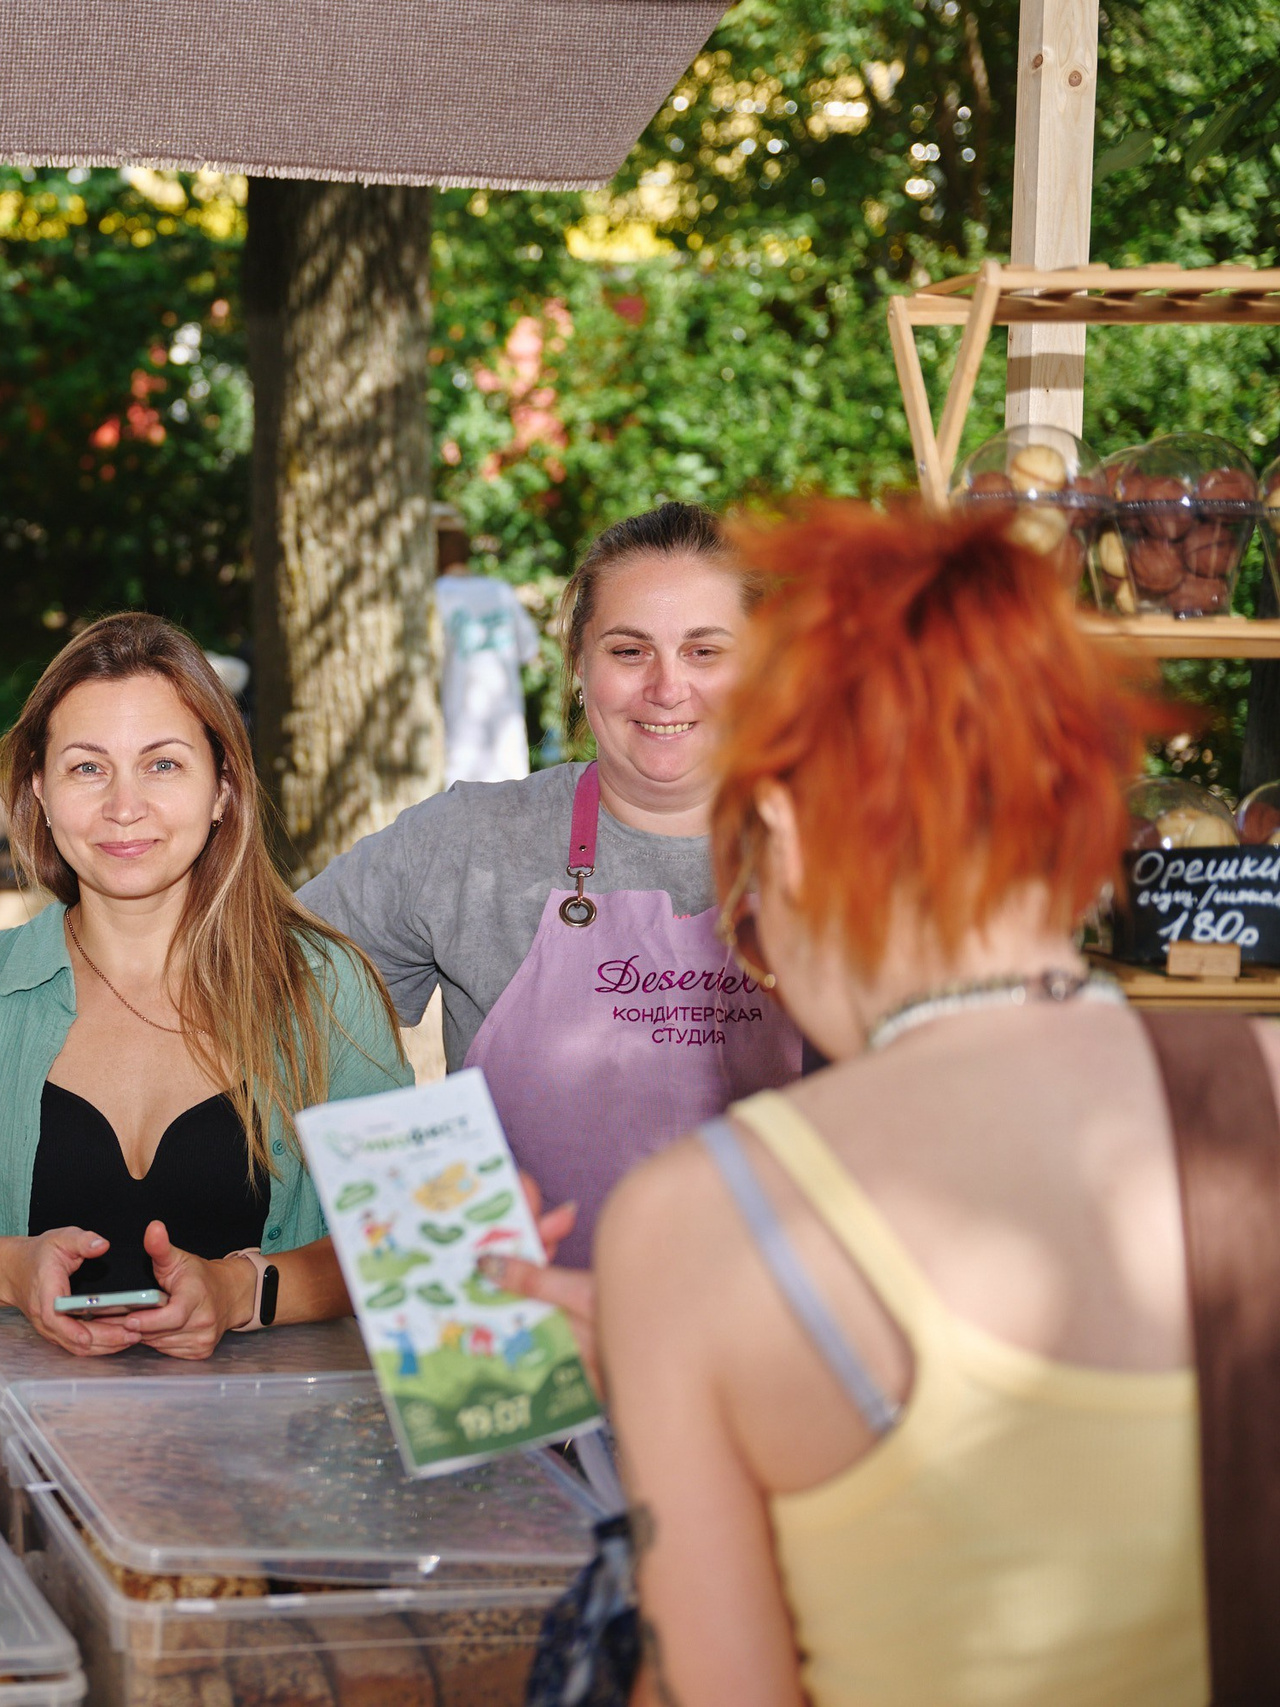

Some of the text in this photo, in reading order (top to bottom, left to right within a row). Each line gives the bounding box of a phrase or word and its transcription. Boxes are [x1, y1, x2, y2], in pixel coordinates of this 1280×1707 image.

[1133, 851, 1280, 890] Орешки
[613, 1006, 763, 1024] КОНДИТЕРСКАЯ
[651, 1028, 726, 1046] СТУДИЯ
